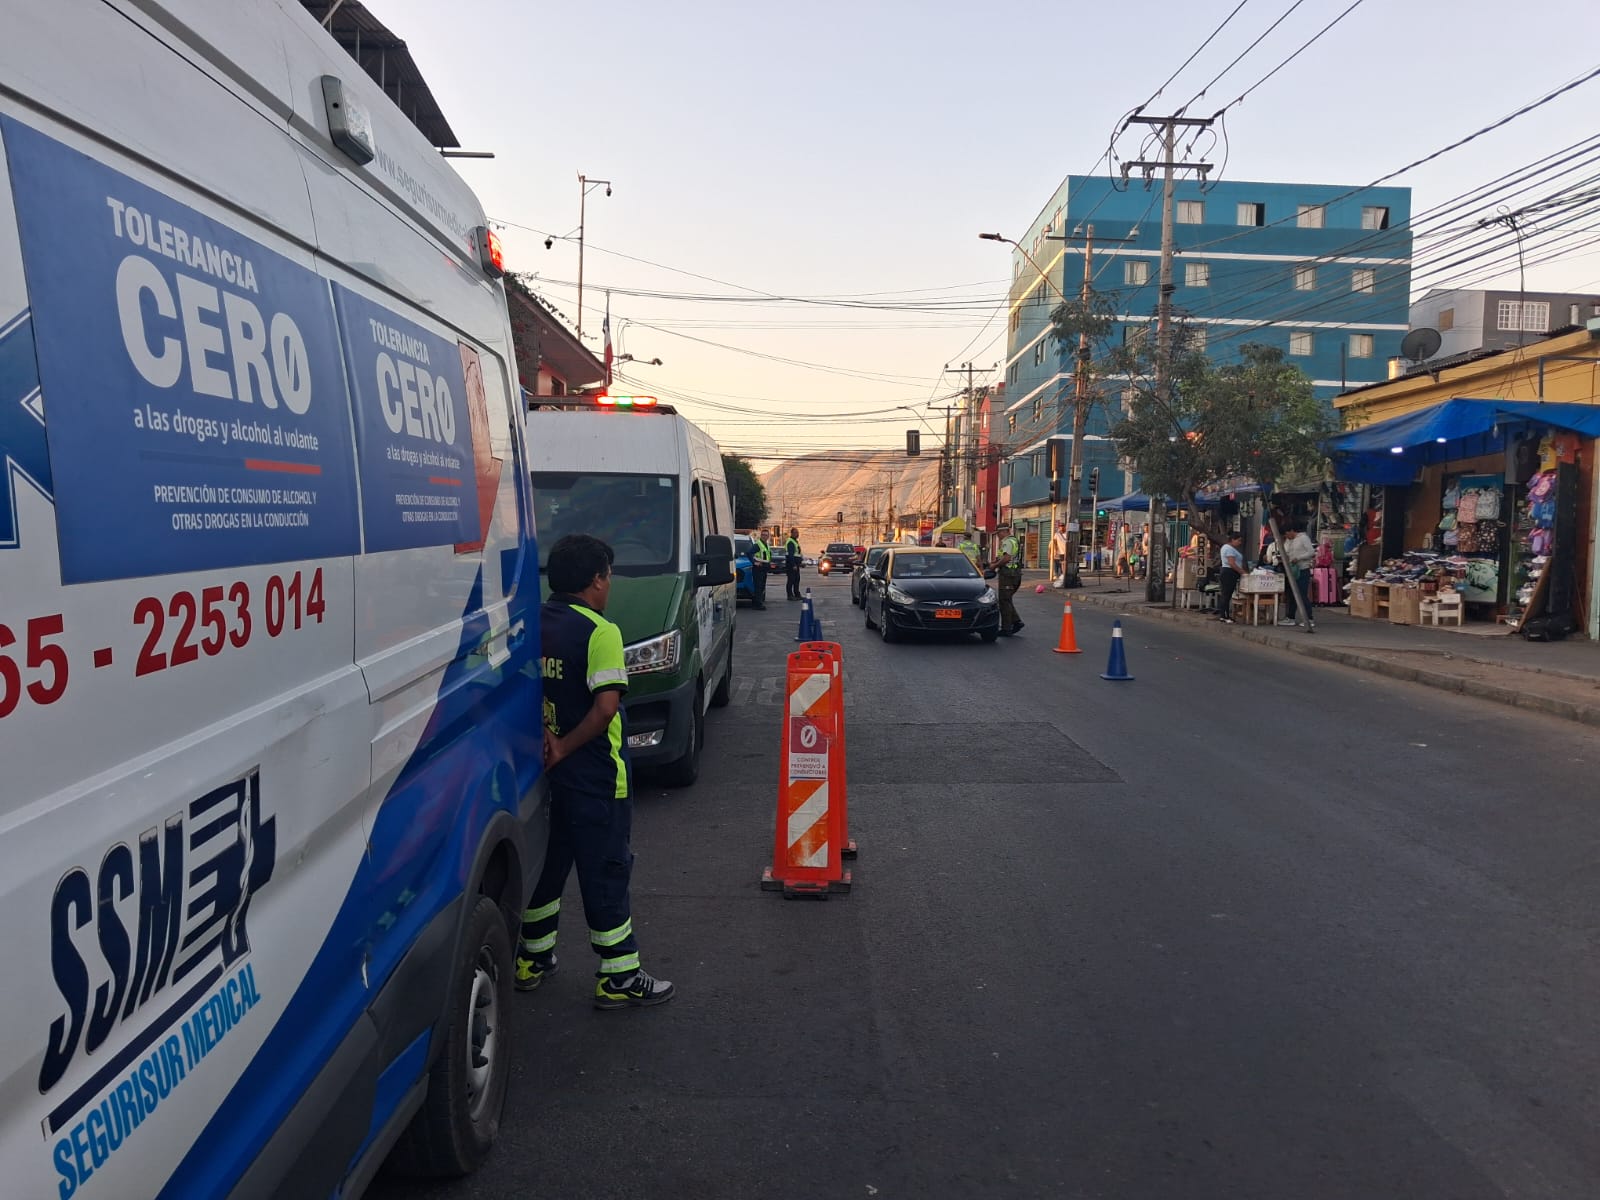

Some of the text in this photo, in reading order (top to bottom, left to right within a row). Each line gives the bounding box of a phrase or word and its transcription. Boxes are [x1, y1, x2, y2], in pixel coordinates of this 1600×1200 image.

[107, 197, 259, 294] TOLERANCIA
[369, 318, 431, 365] TOLERANCIA
[133, 404, 319, 451] a las drogas y alcohol al volante
[154, 484, 317, 505] PREVENCIÓN DE CONSUMO DE ALCOHOL Y
[172, 510, 309, 530] OTRAS DROGAS EN LA CONDUCCIÓN
[93, 647, 113, 668] -
[133, 581, 251, 677] 2253
[265, 567, 325, 638] 014
[38, 811, 184, 1095] SSM
[53, 962, 261, 1200] SEGURISUR MEDICAL
